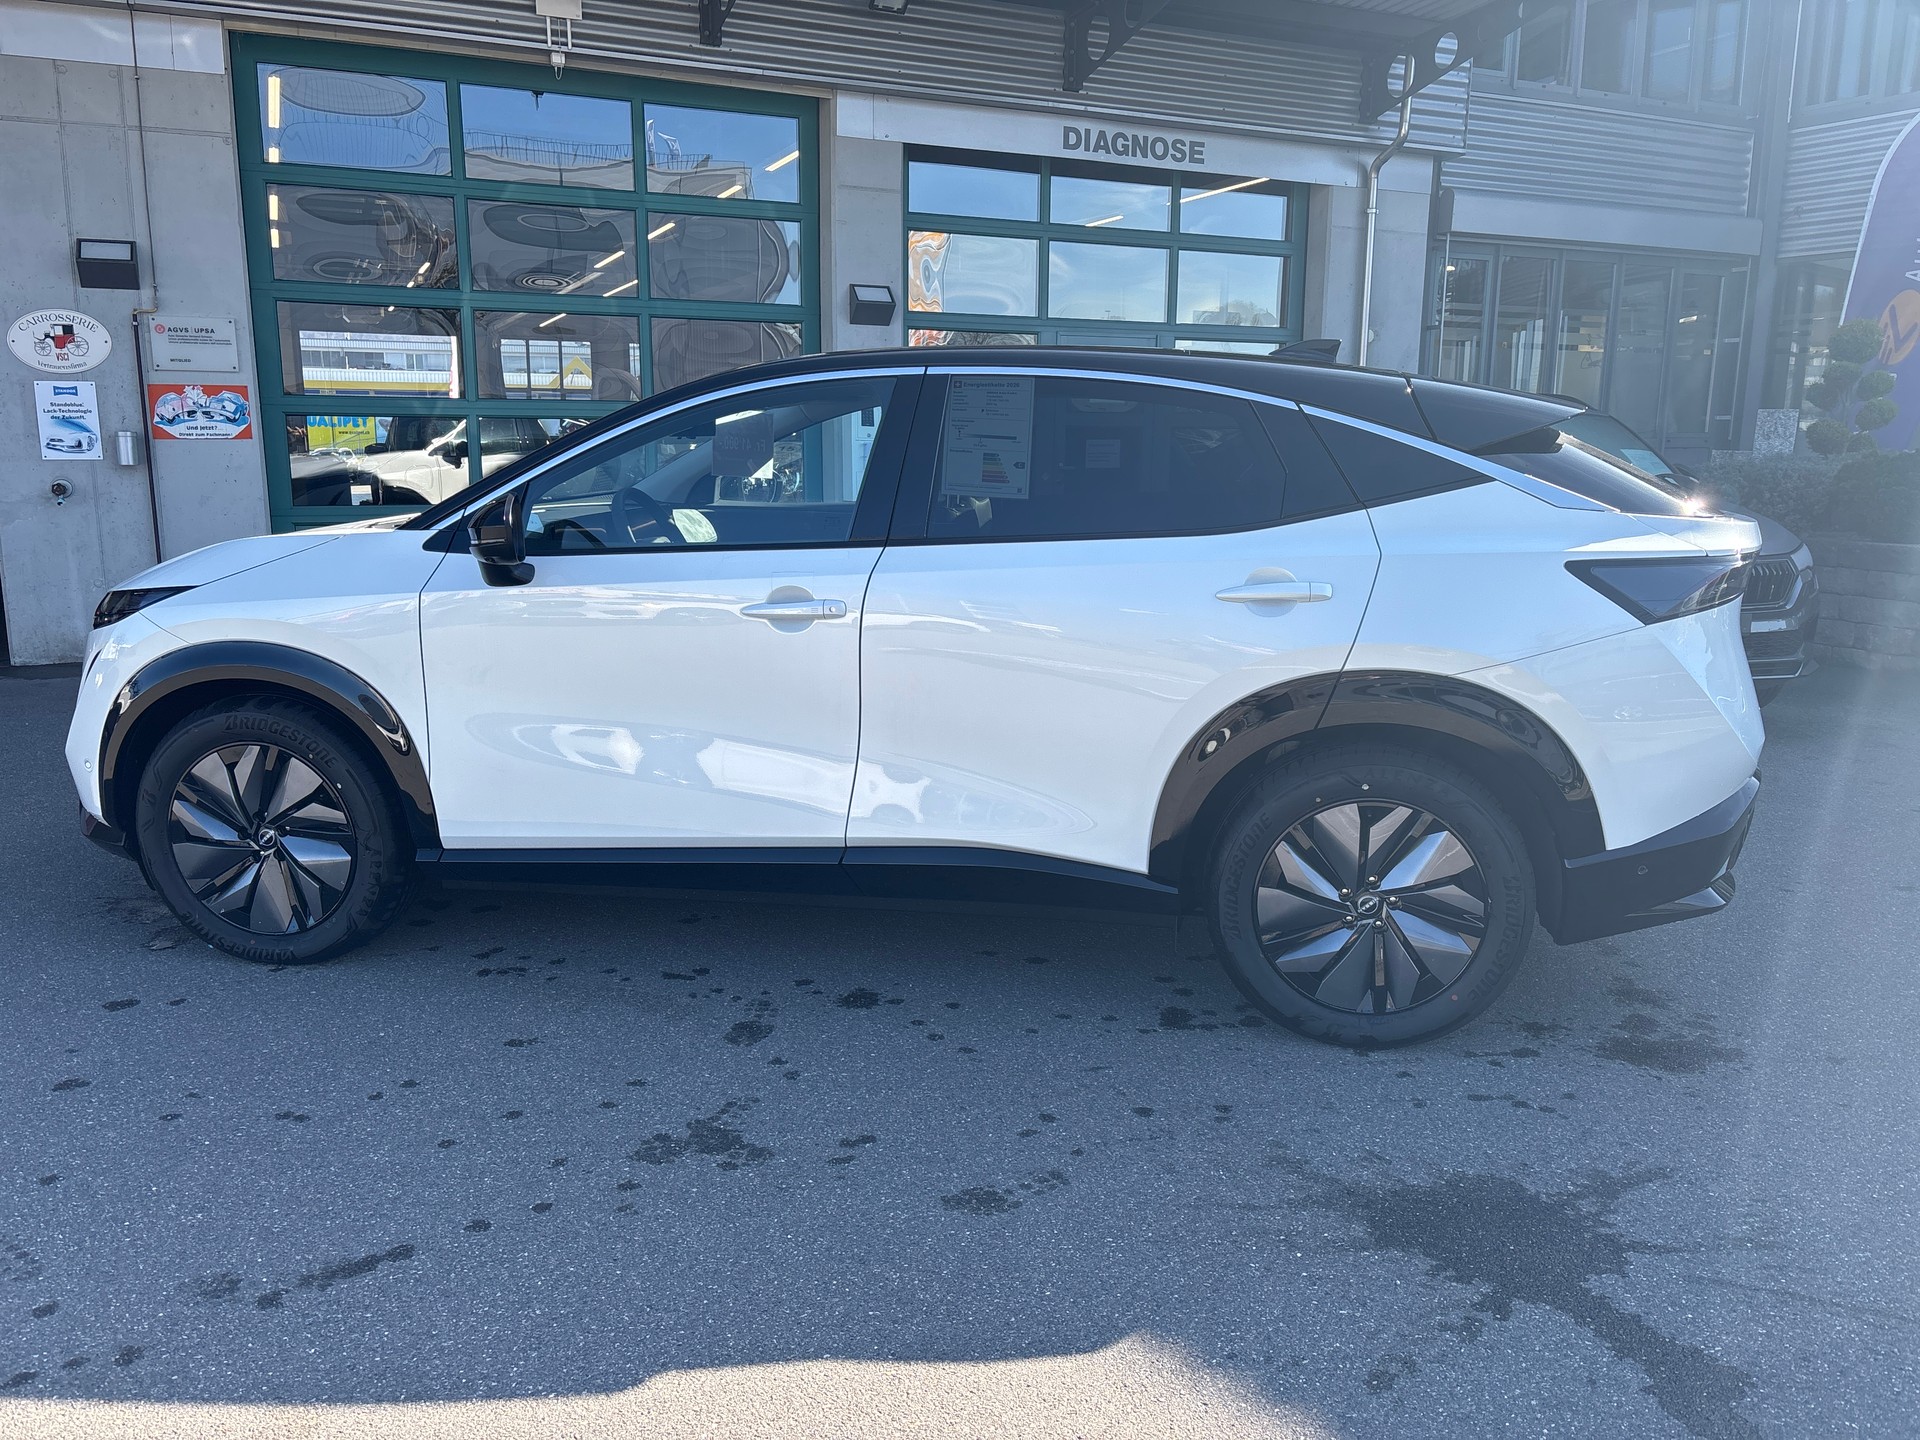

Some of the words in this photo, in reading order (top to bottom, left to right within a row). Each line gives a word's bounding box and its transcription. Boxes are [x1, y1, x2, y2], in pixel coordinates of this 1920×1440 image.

[1062, 126, 1206, 165] DIAGNOSE
[18, 313, 99, 333] CARROSSERIE
[37, 360, 88, 370] Vertrauensfirma
[55, 353, 70, 361] VSCI
[223, 714, 337, 769] BRIDGESTONE
[1223, 812, 1274, 941] BRIDGESTONE
[1467, 875, 1523, 1002] BRIDGESTONE
